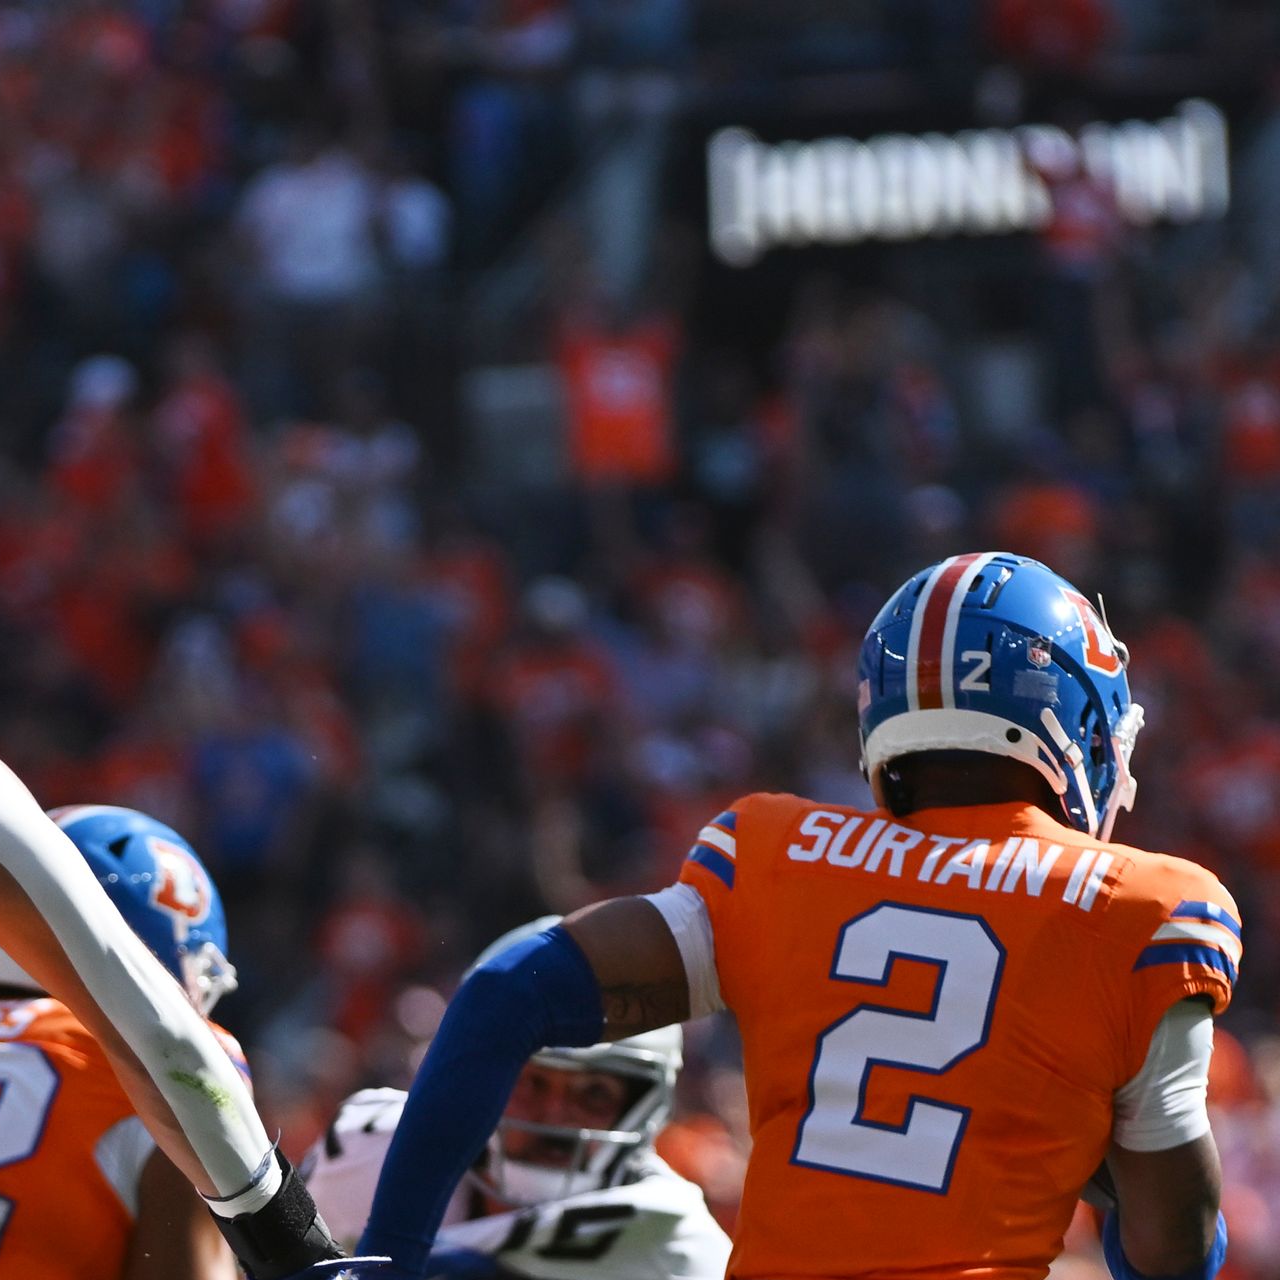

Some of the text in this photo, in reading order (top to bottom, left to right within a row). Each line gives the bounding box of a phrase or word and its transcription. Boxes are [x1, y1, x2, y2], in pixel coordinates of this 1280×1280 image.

[959, 651, 991, 692] 2
[786, 810, 1115, 913] SURTAIN II
[789, 900, 1007, 1195] 2
